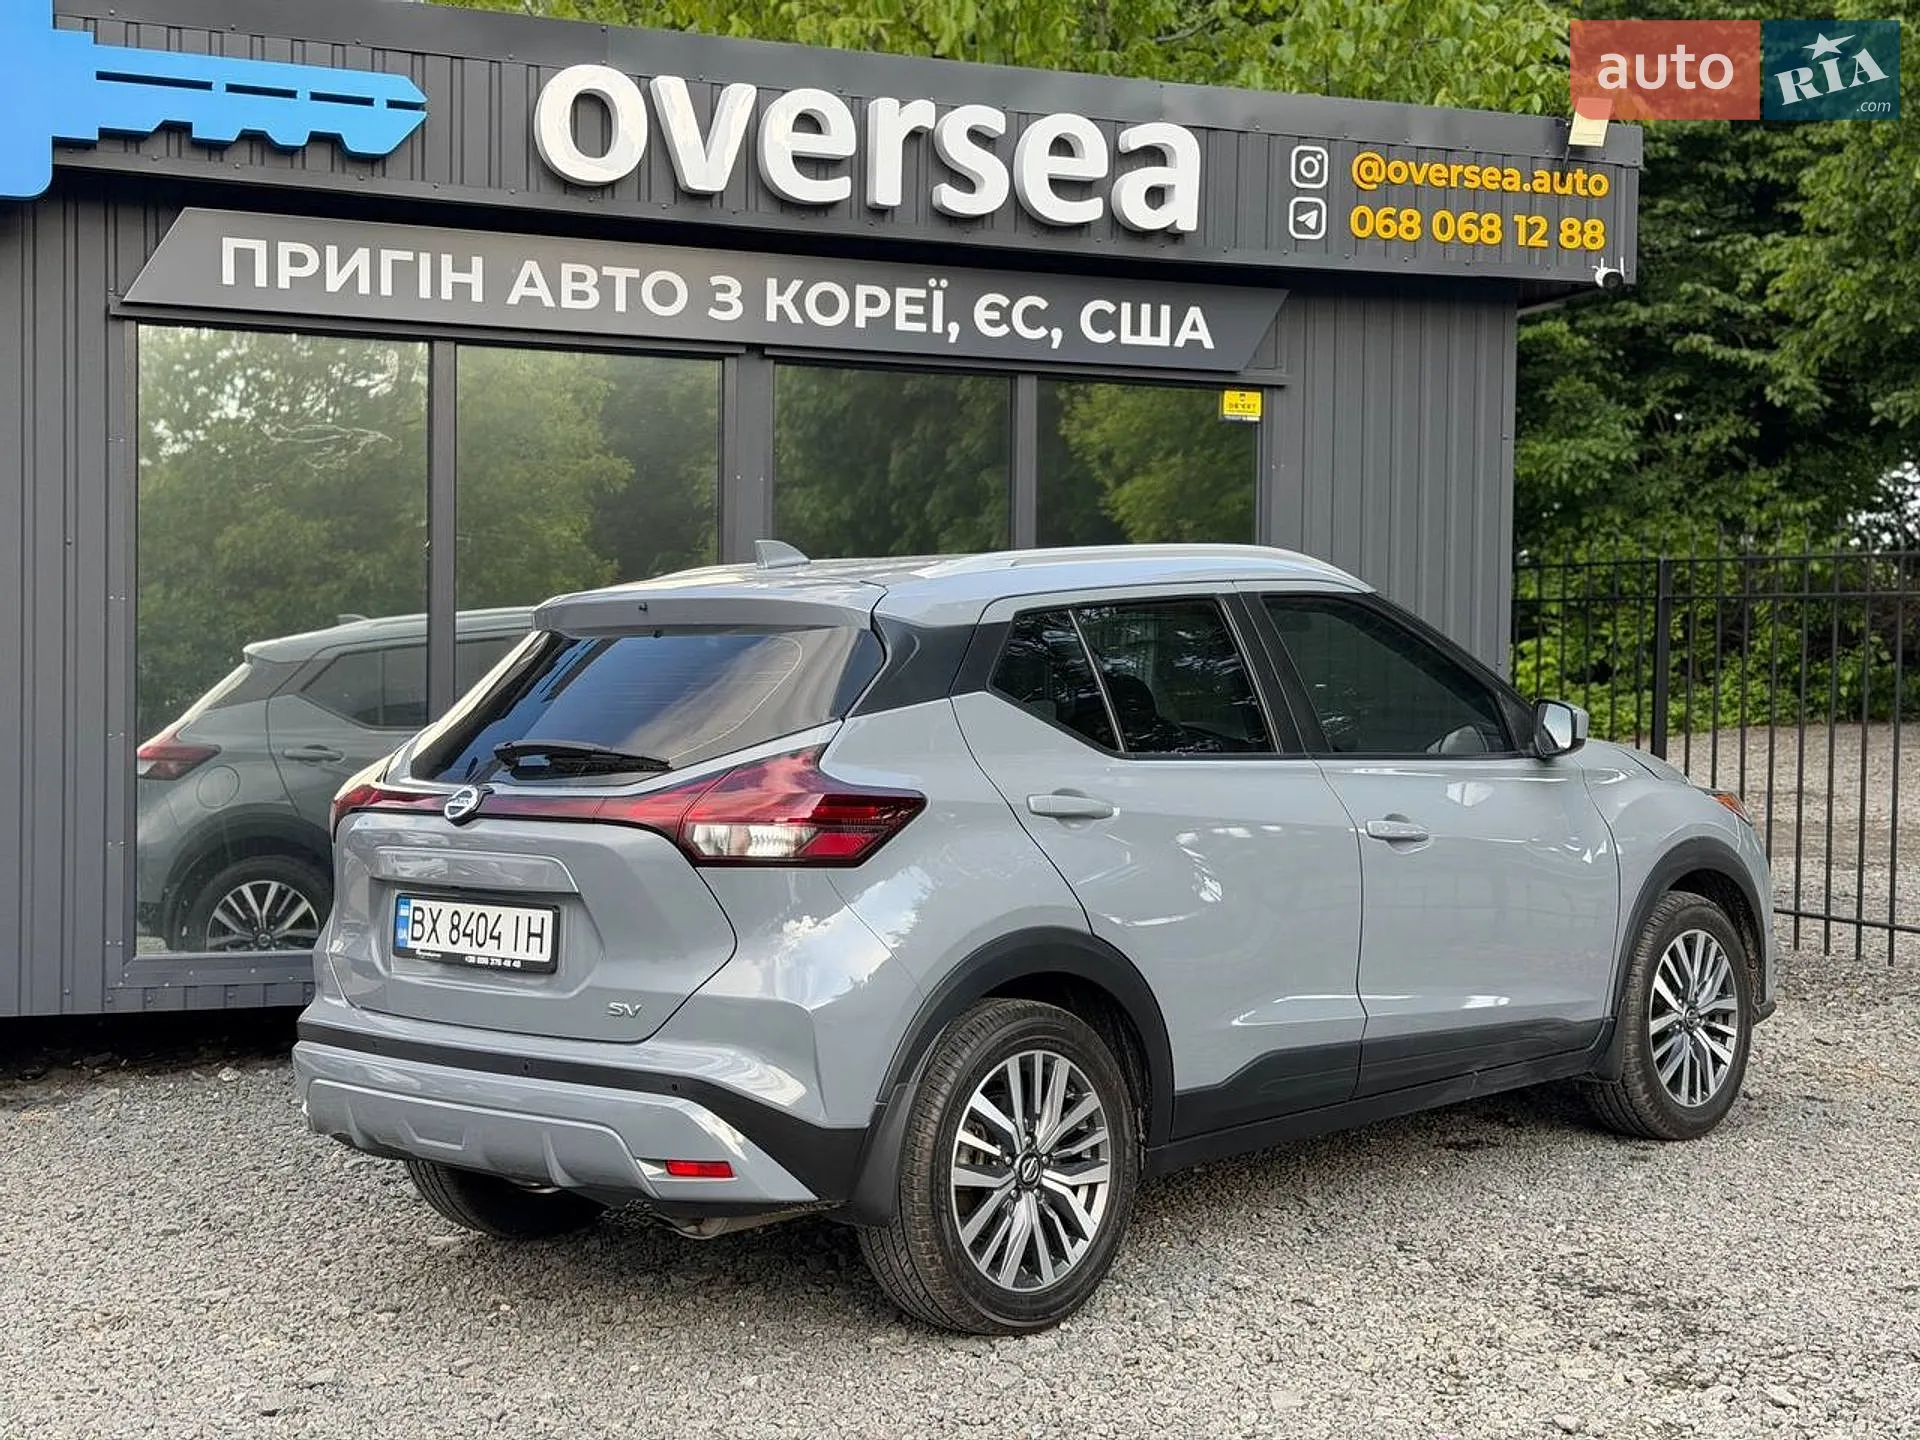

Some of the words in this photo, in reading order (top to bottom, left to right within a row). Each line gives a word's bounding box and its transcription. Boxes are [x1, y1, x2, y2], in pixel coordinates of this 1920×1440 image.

[534, 64, 1200, 232] oversea
[1351, 151, 1610, 198] @oversea.auto
[1350, 205, 1422, 242] 068
[1432, 210, 1503, 246] 068
[1514, 214, 1549, 249] 12
[1558, 217, 1606, 252] 88
[221, 236, 484, 303] ПРИГІН
[506, 259, 689, 317] АВТО
[766, 278, 961, 343] КОРЕЇ,
[974, 294, 1063, 350] ЄС,
[1079, 300, 1215, 350] США
[410, 906, 442, 944] BX
[449, 910, 502, 950] 8404
[513, 915, 545, 954] IH
[607, 1002, 642, 1018] SV
